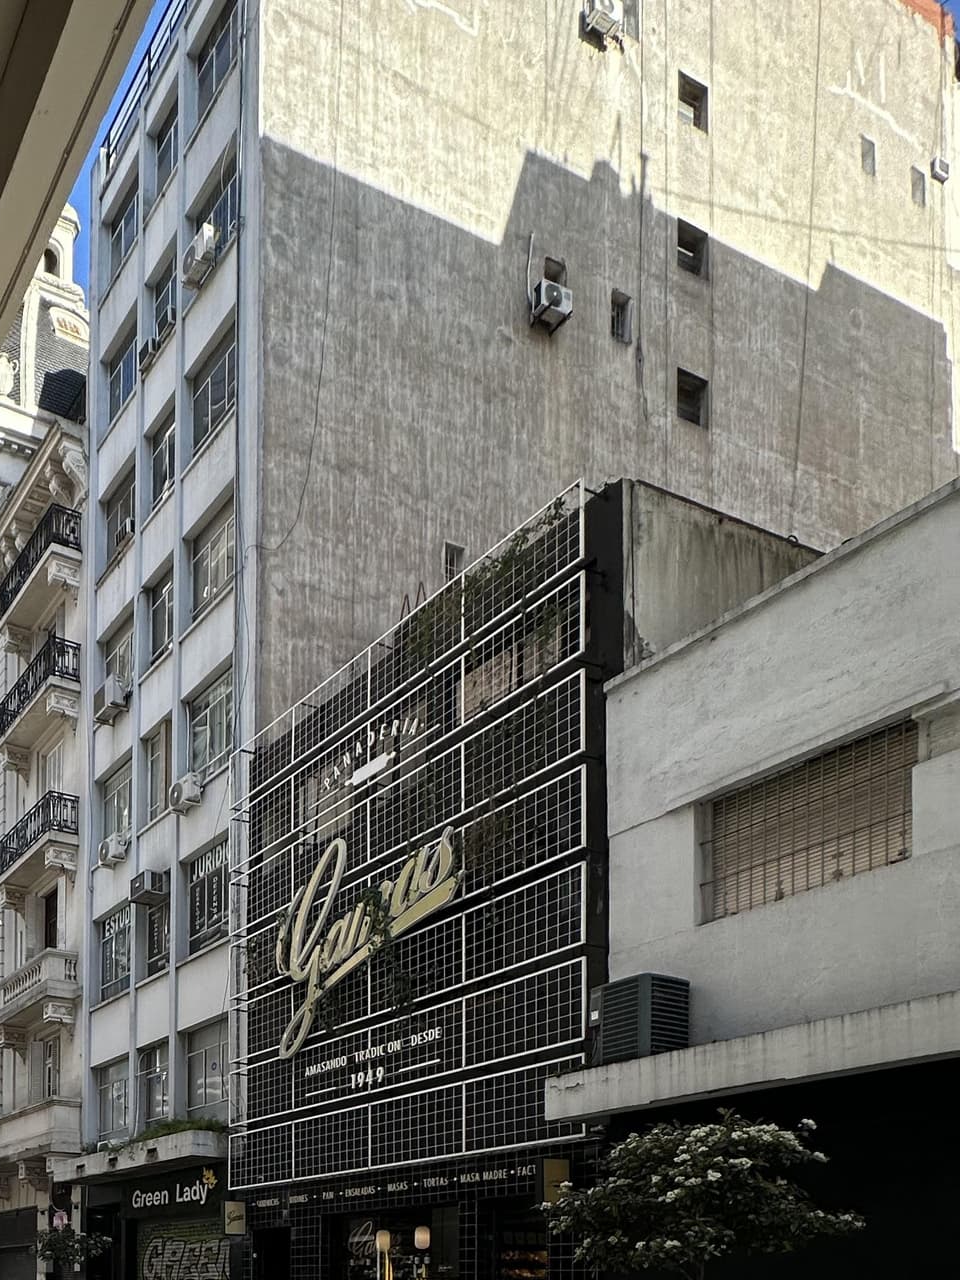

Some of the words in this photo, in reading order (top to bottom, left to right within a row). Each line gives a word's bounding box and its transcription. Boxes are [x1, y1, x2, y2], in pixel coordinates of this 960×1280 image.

[323, 717, 419, 790] PANADERIA
[304, 1055, 348, 1078] AMASANDO
[411, 1027, 442, 1046] DESDE
[351, 1067, 384, 1088] 1949
[132, 1189, 169, 1208] Green
[176, 1180, 208, 1205] Lady
[344, 1185, 377, 1198] ENSALADAS
[387, 1181, 408, 1192] MASAS
[422, 1176, 449, 1188] TORTAS
[460, 1172, 480, 1183] MASA
[482, 1168, 509, 1181] MADRE
